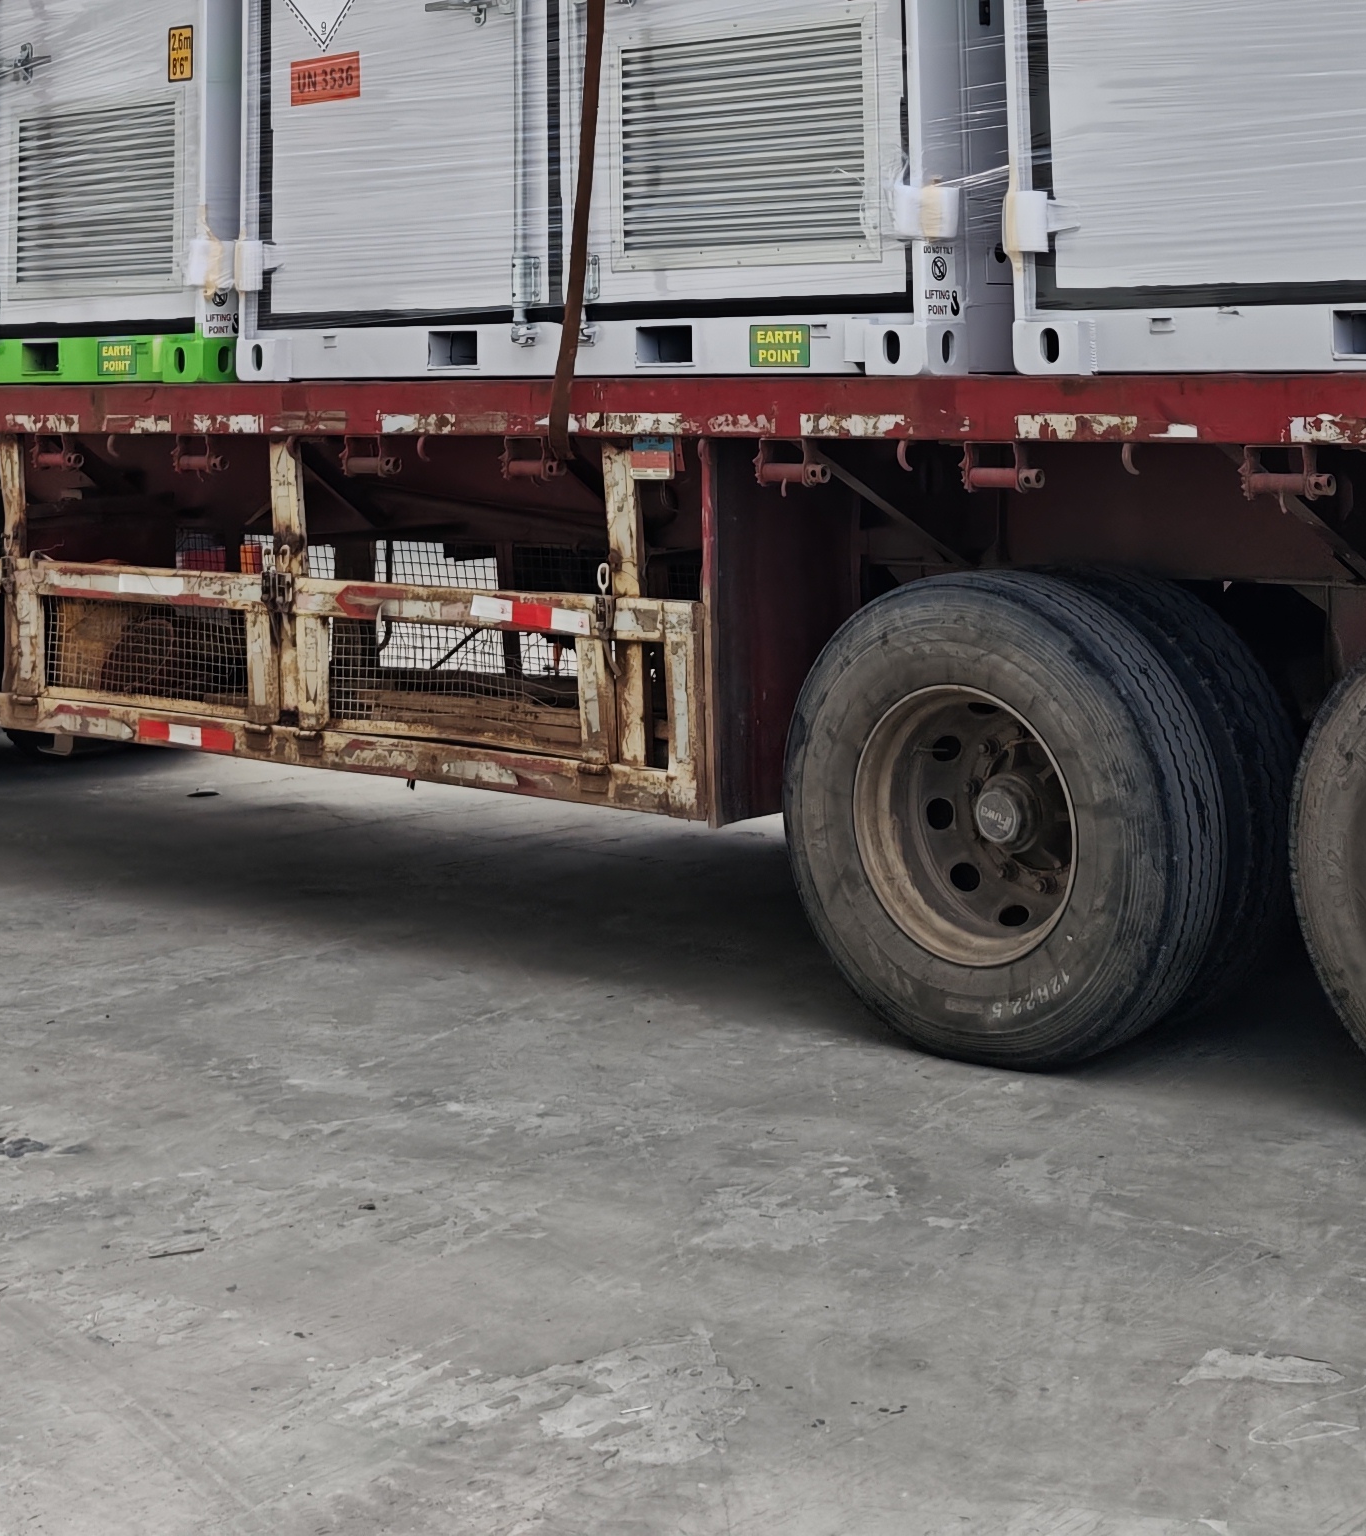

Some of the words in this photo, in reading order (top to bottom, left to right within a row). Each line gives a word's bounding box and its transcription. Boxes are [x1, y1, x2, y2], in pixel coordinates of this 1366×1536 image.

[171, 32, 191, 54] 2,6m
[297, 72, 317, 93] UN
[321, 66, 354, 89] 3536
[925, 289, 950, 300] LIFTING
[928, 305, 947, 315] POINT
[206, 314, 231, 322] LIFTING
[208, 326, 228, 334] POINT
[757, 331, 802, 343] EARTH
[102, 345, 131, 356] EARTH
[758, 350, 800, 362] POINT
[103, 360, 131, 371] POINT
